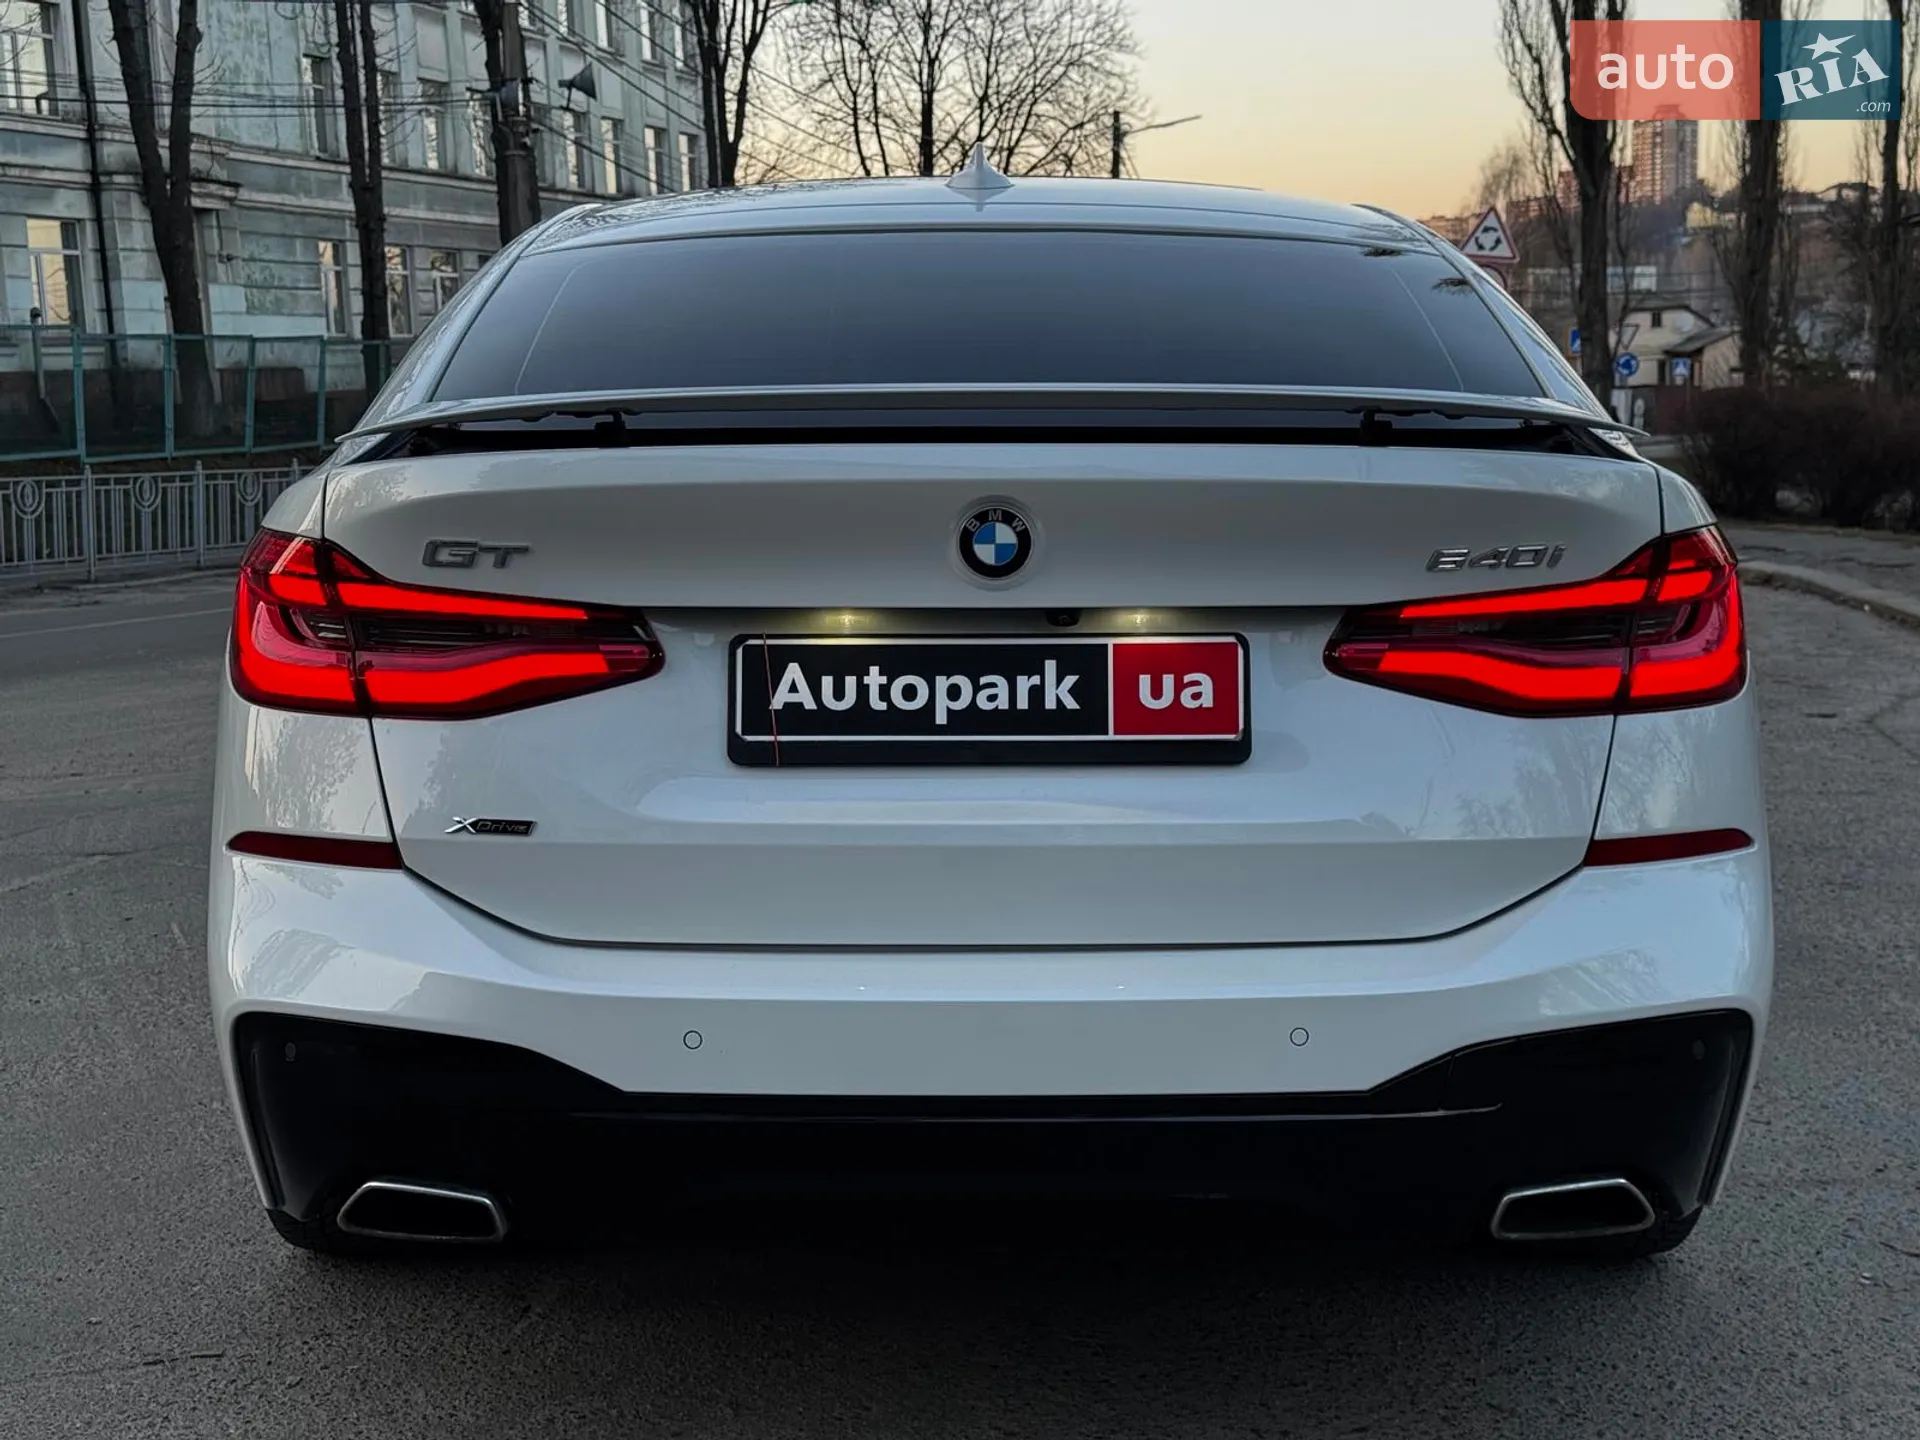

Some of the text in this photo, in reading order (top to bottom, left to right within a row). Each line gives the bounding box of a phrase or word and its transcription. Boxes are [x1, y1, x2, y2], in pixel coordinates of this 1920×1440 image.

[965, 509, 1026, 533] BMW
[422, 538, 533, 569] GT
[1426, 543, 1567, 572] 640i
[769, 660, 1214, 725] Autopark ua
